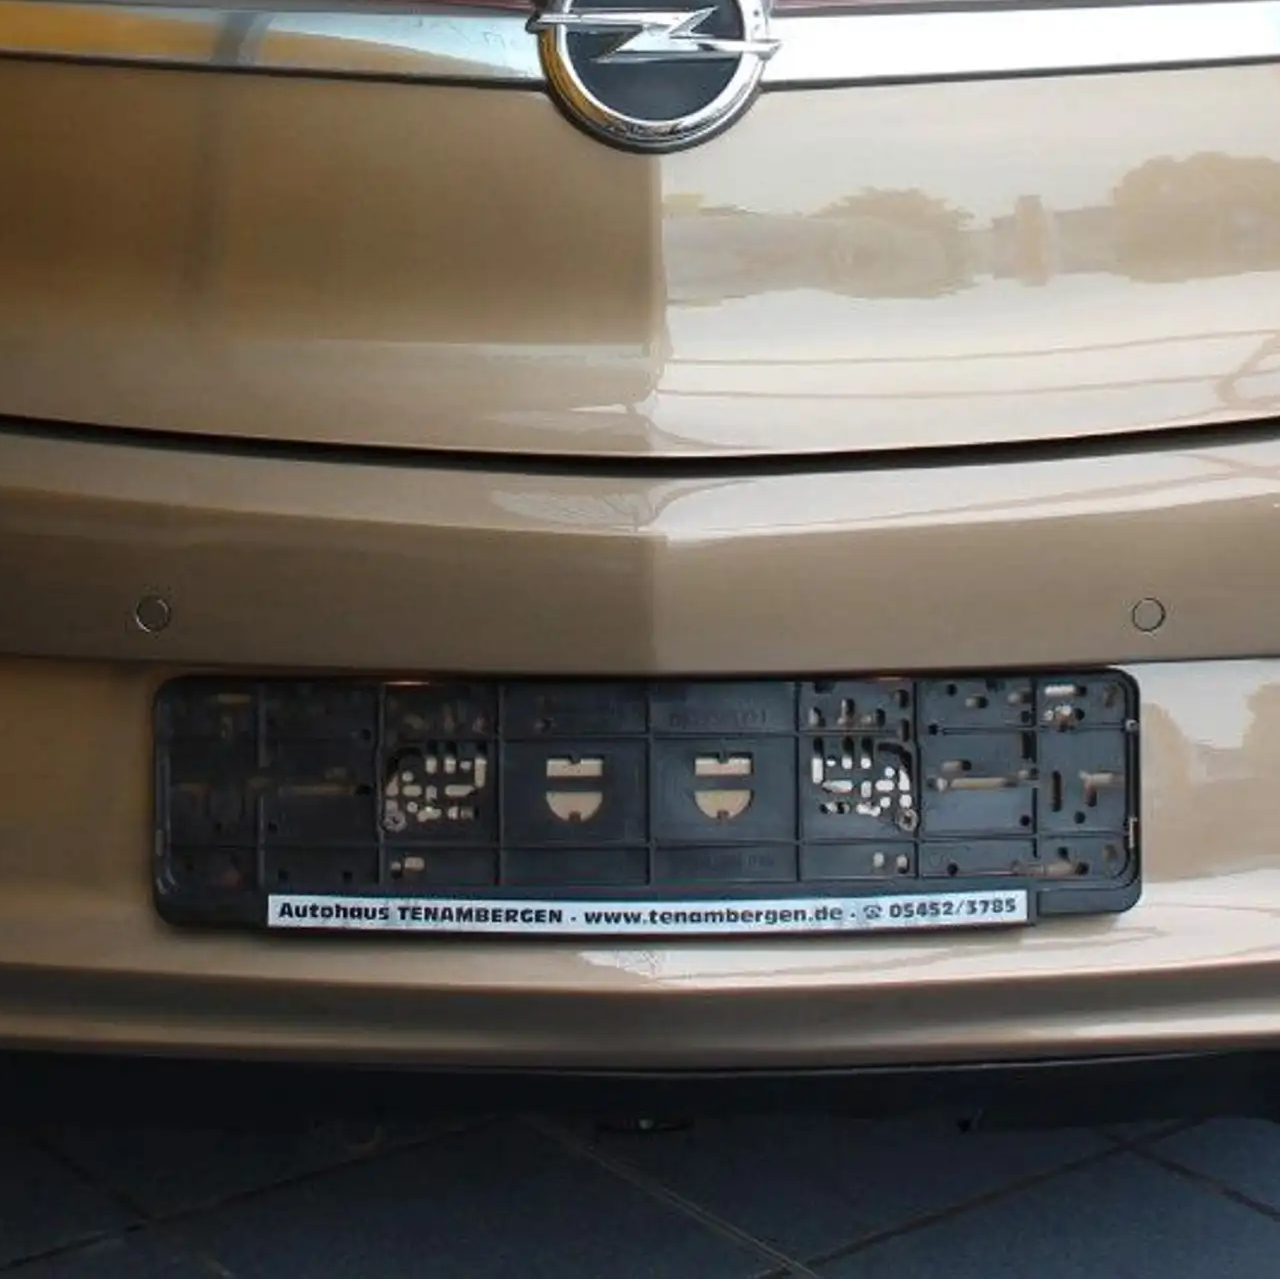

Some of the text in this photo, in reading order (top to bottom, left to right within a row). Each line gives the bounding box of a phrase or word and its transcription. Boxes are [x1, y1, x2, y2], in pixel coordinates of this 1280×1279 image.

[278, 897, 1017, 926] Autohaus TENAMBERGEN www.tenambergen.de 05452/3785
